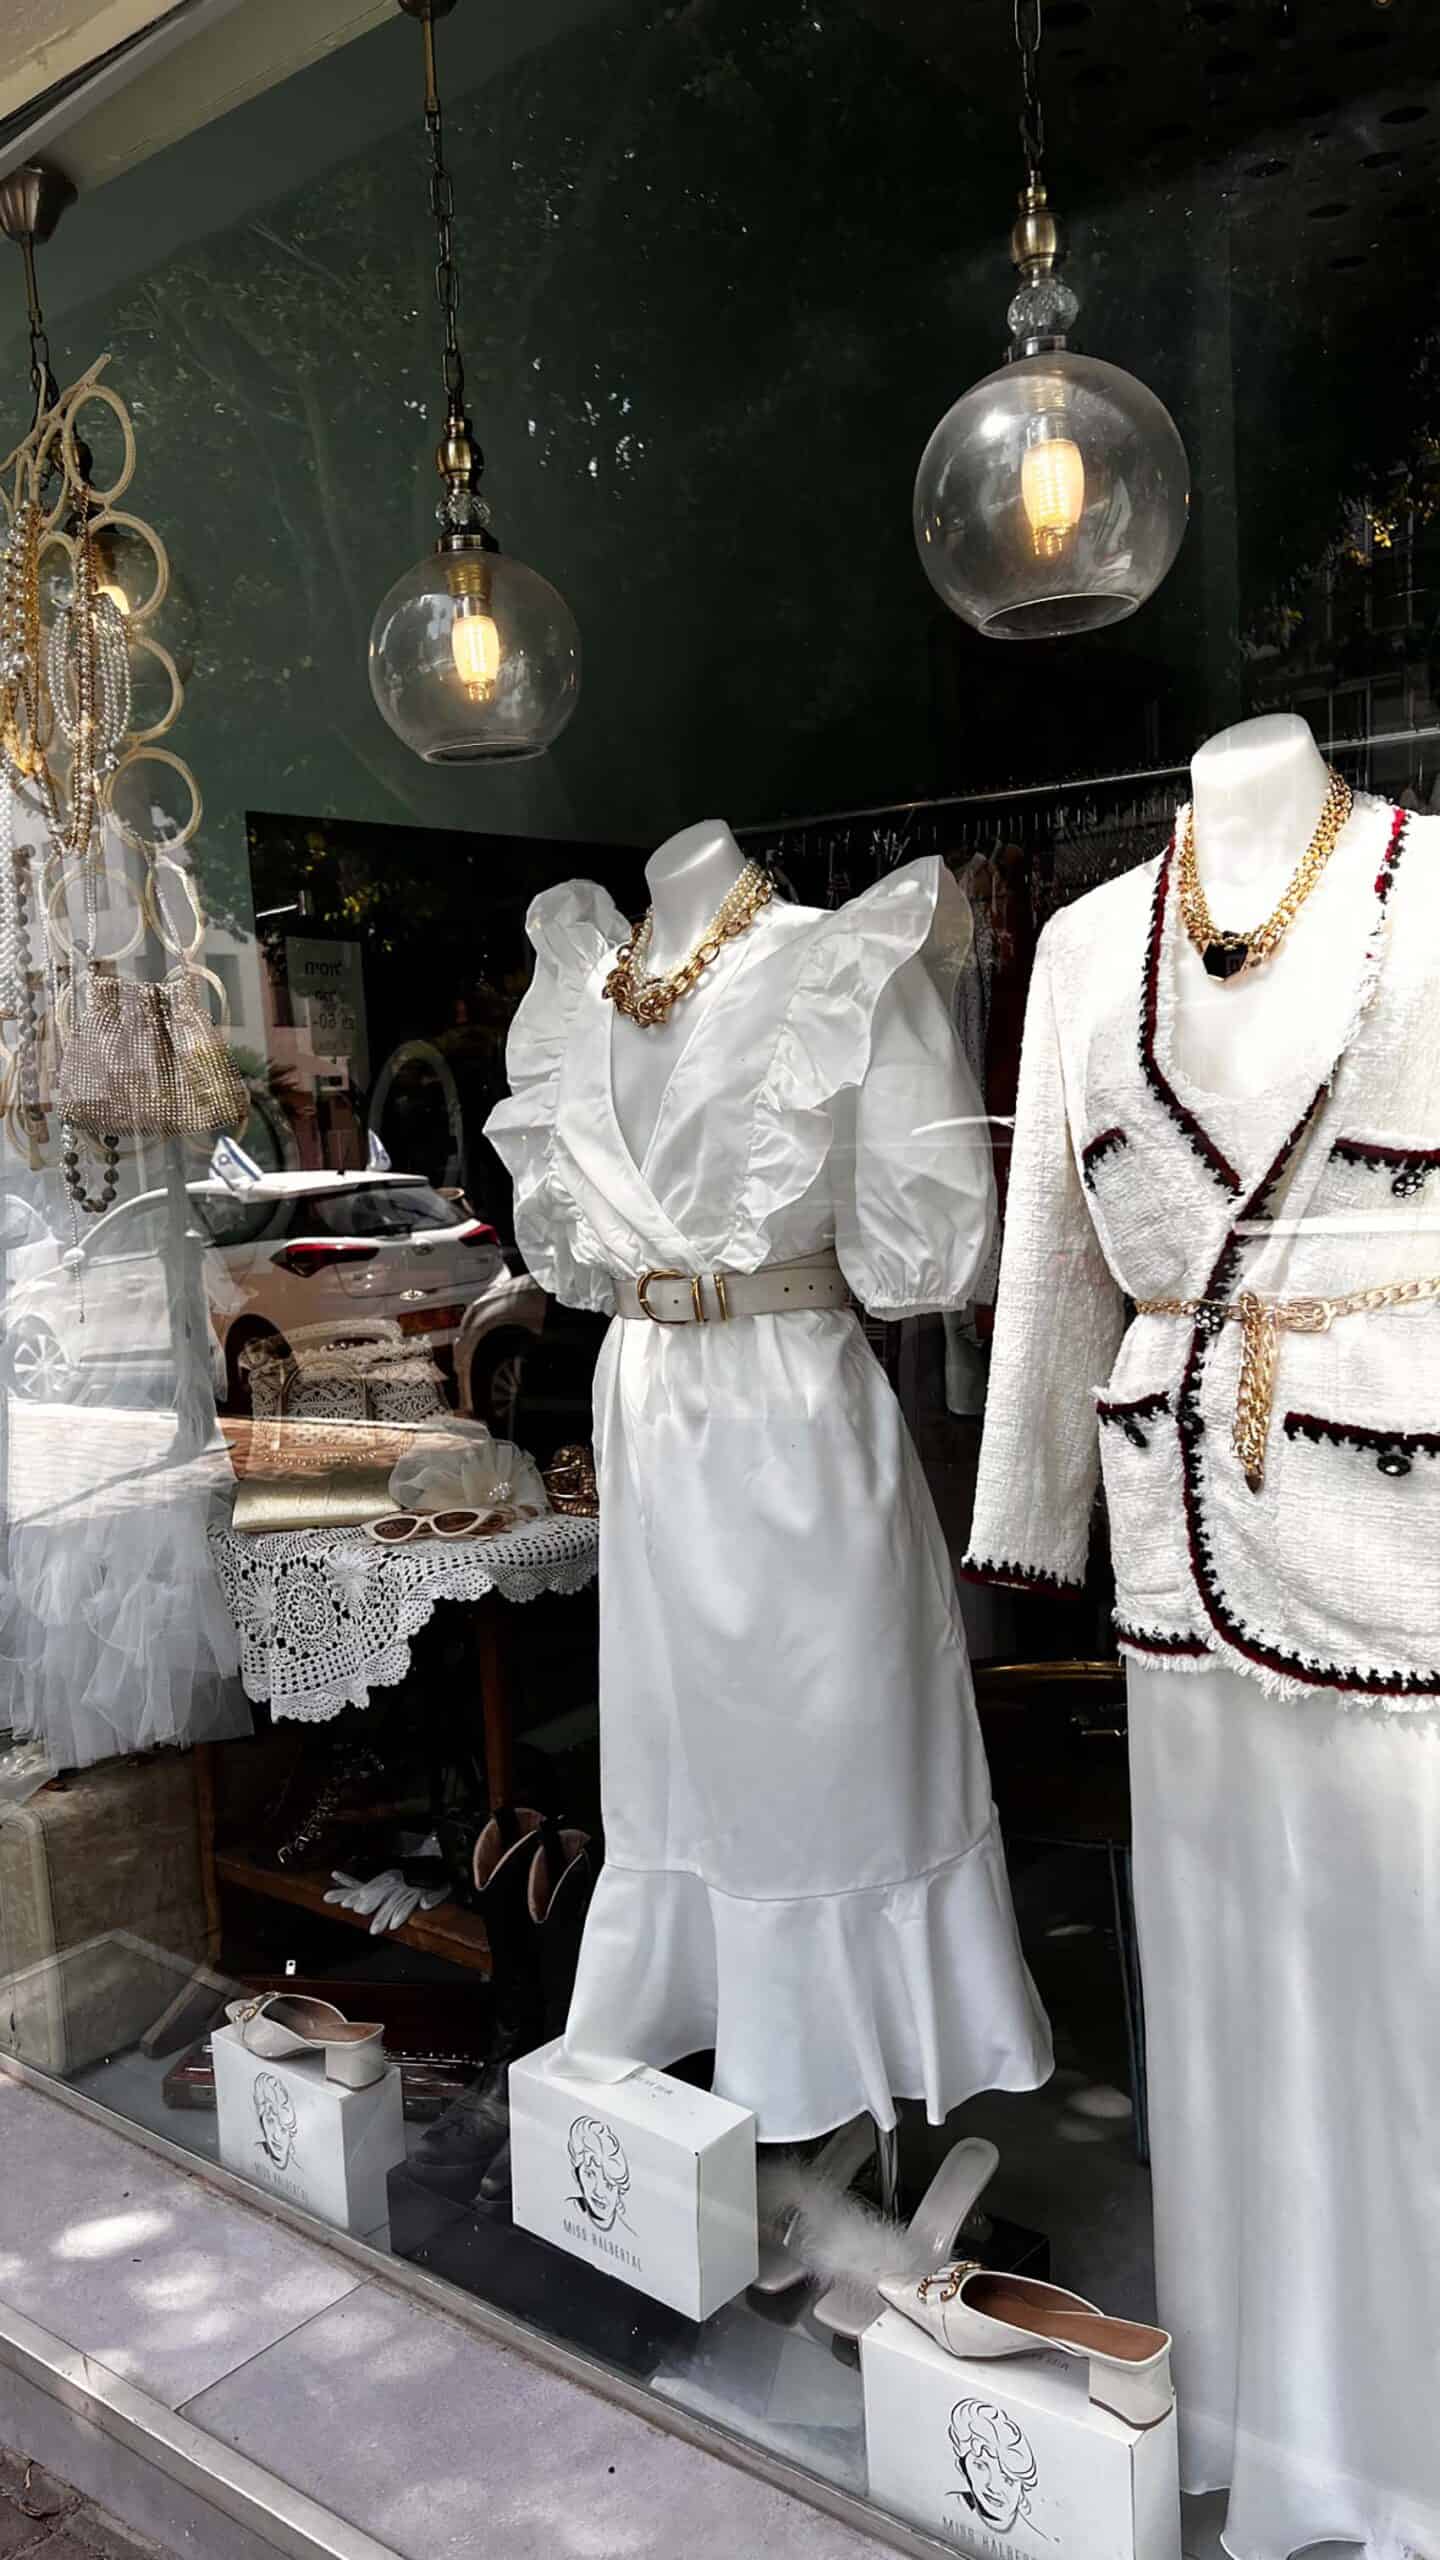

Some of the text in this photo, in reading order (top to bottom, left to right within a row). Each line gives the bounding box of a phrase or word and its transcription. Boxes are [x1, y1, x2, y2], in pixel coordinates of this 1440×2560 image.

[563, 2217, 643, 2273] MISS HALBERTAL
[942, 2514, 976, 2545] MISS
